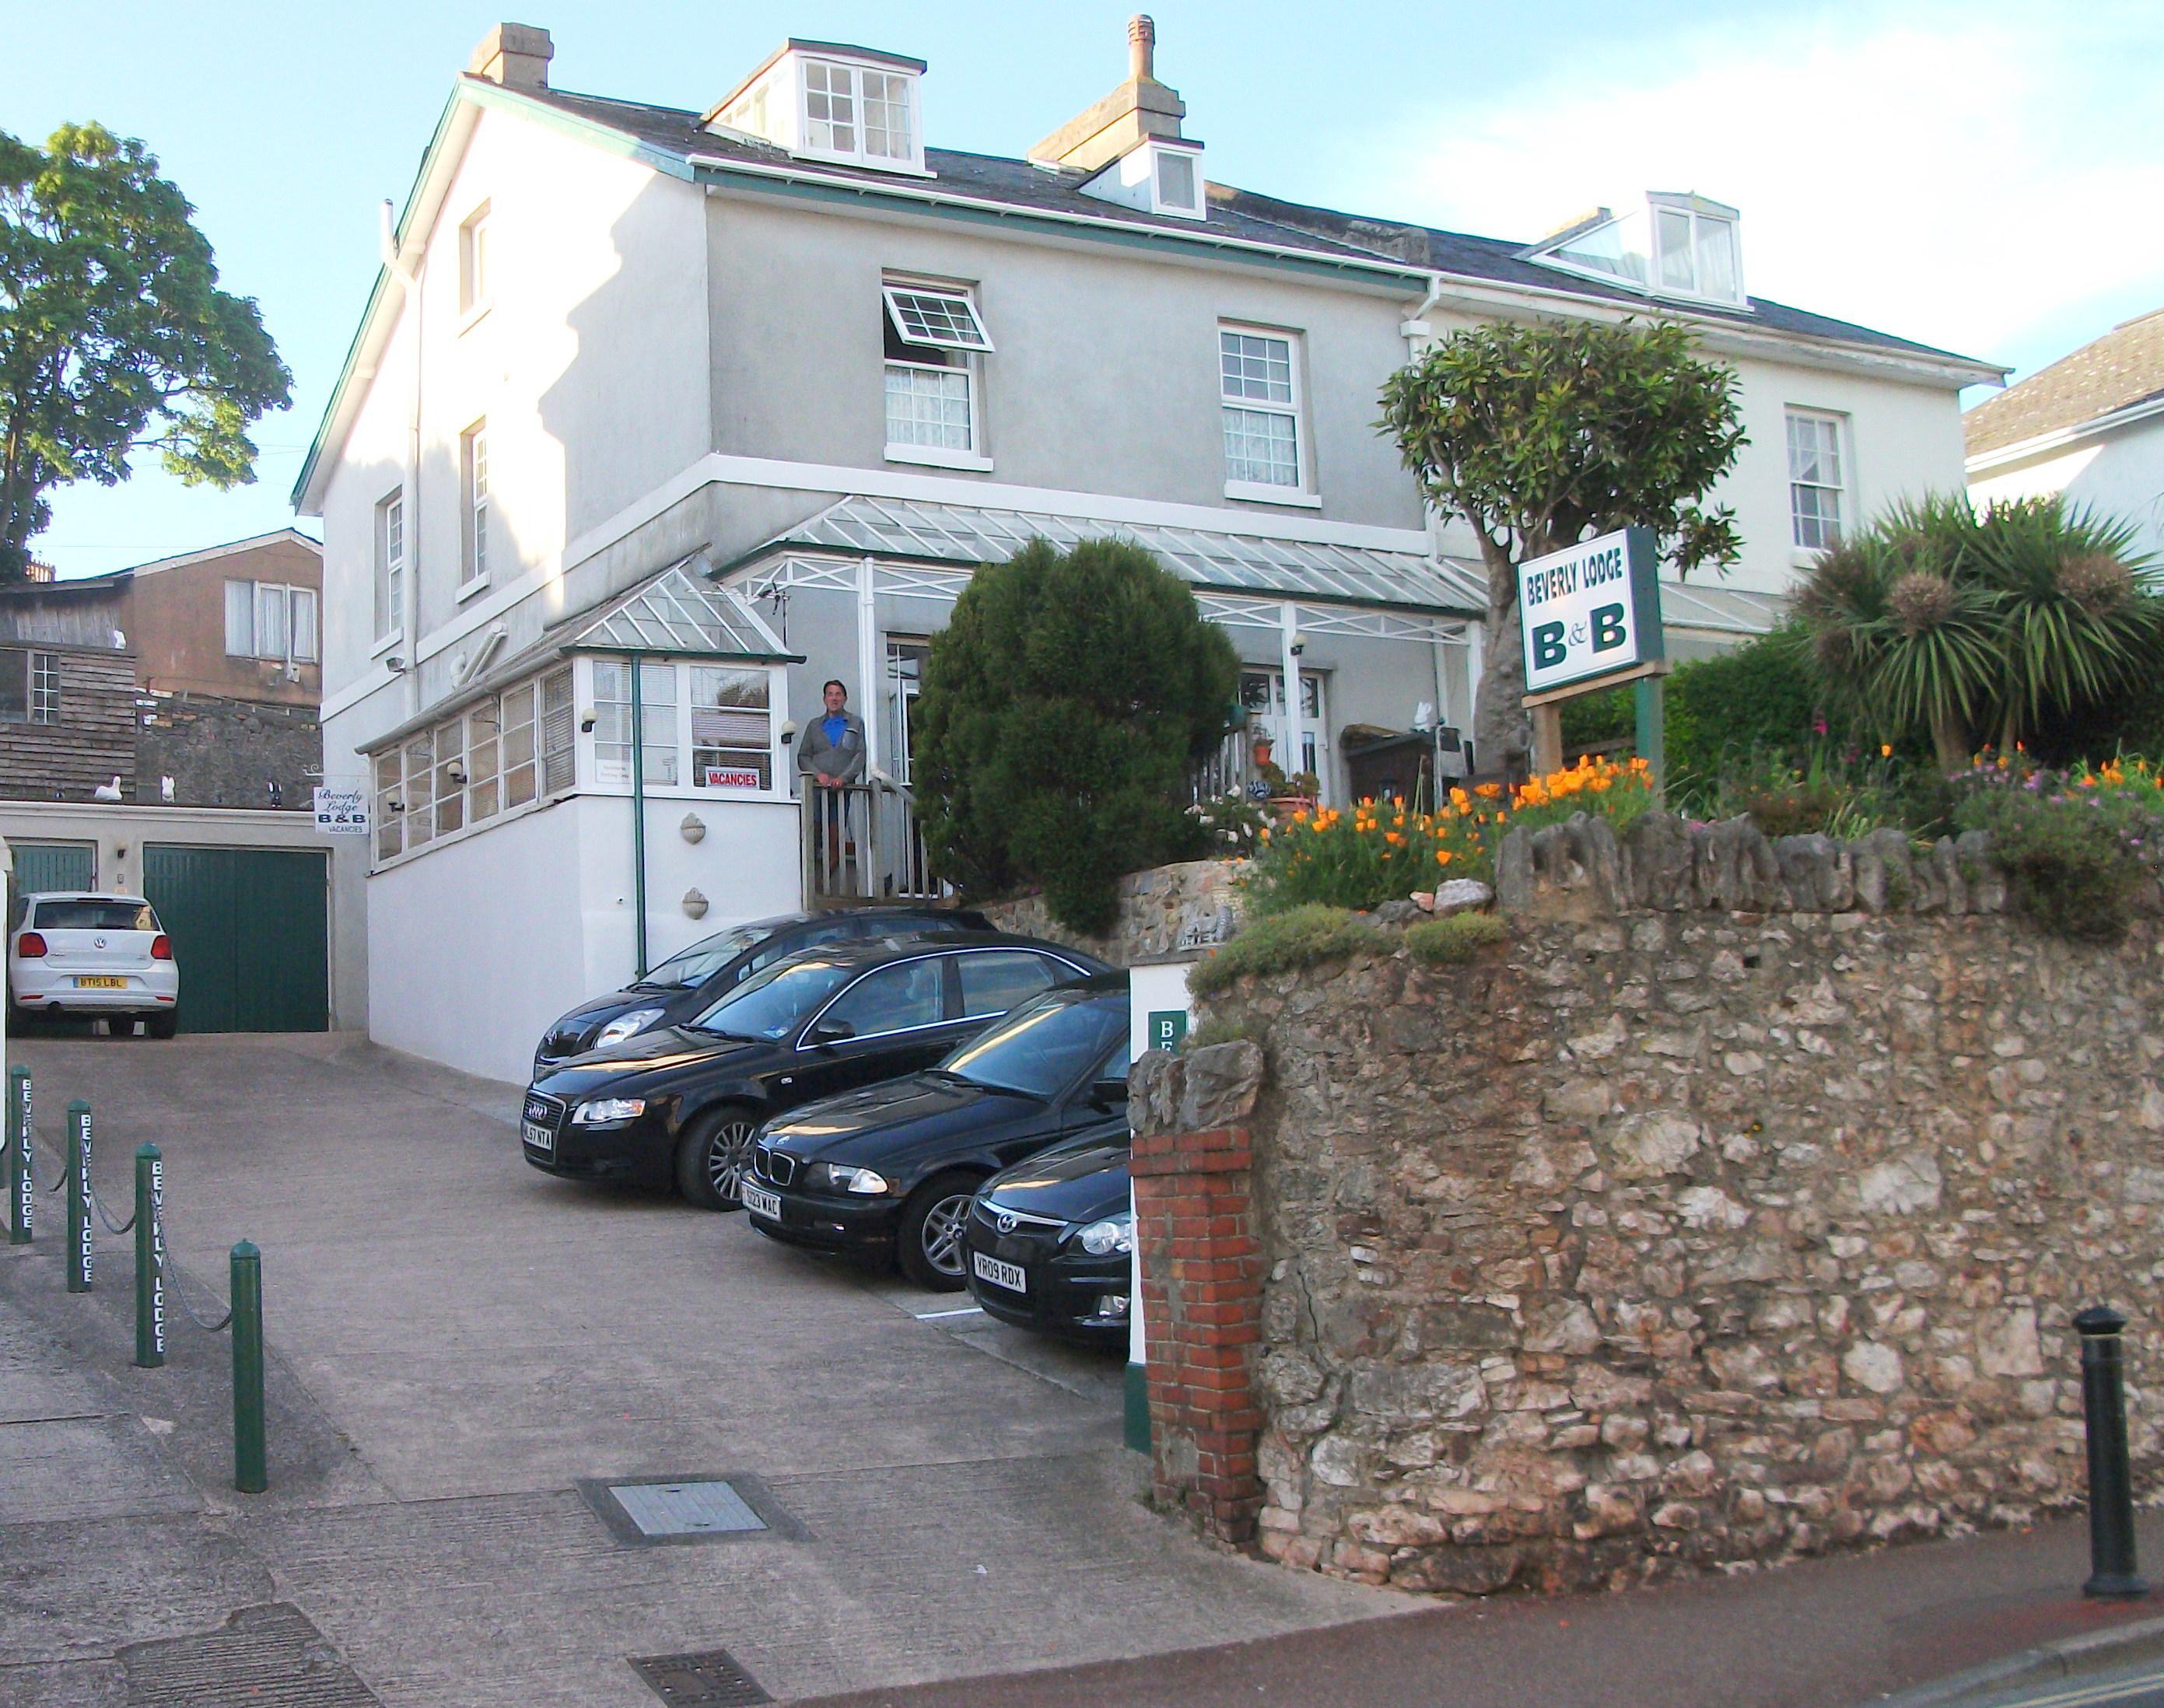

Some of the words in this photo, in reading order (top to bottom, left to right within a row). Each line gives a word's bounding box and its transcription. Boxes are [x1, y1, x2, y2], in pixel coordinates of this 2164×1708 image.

[1527, 561, 1578, 607] BEVERLY
[1582, 547, 1623, 589] LODGE
[318, 789, 362, 803] Beverly
[709, 772, 757, 786] VACANCIES
[324, 800, 358, 814] Lodge
[22, 1169, 33, 1228] LODGE
[82, 1216, 93, 1283] LODGE
[977, 1256, 1000, 1280] YR09
[1002, 1265, 1021, 1288] RDX
[153, 1277, 164, 1353] LODGE
